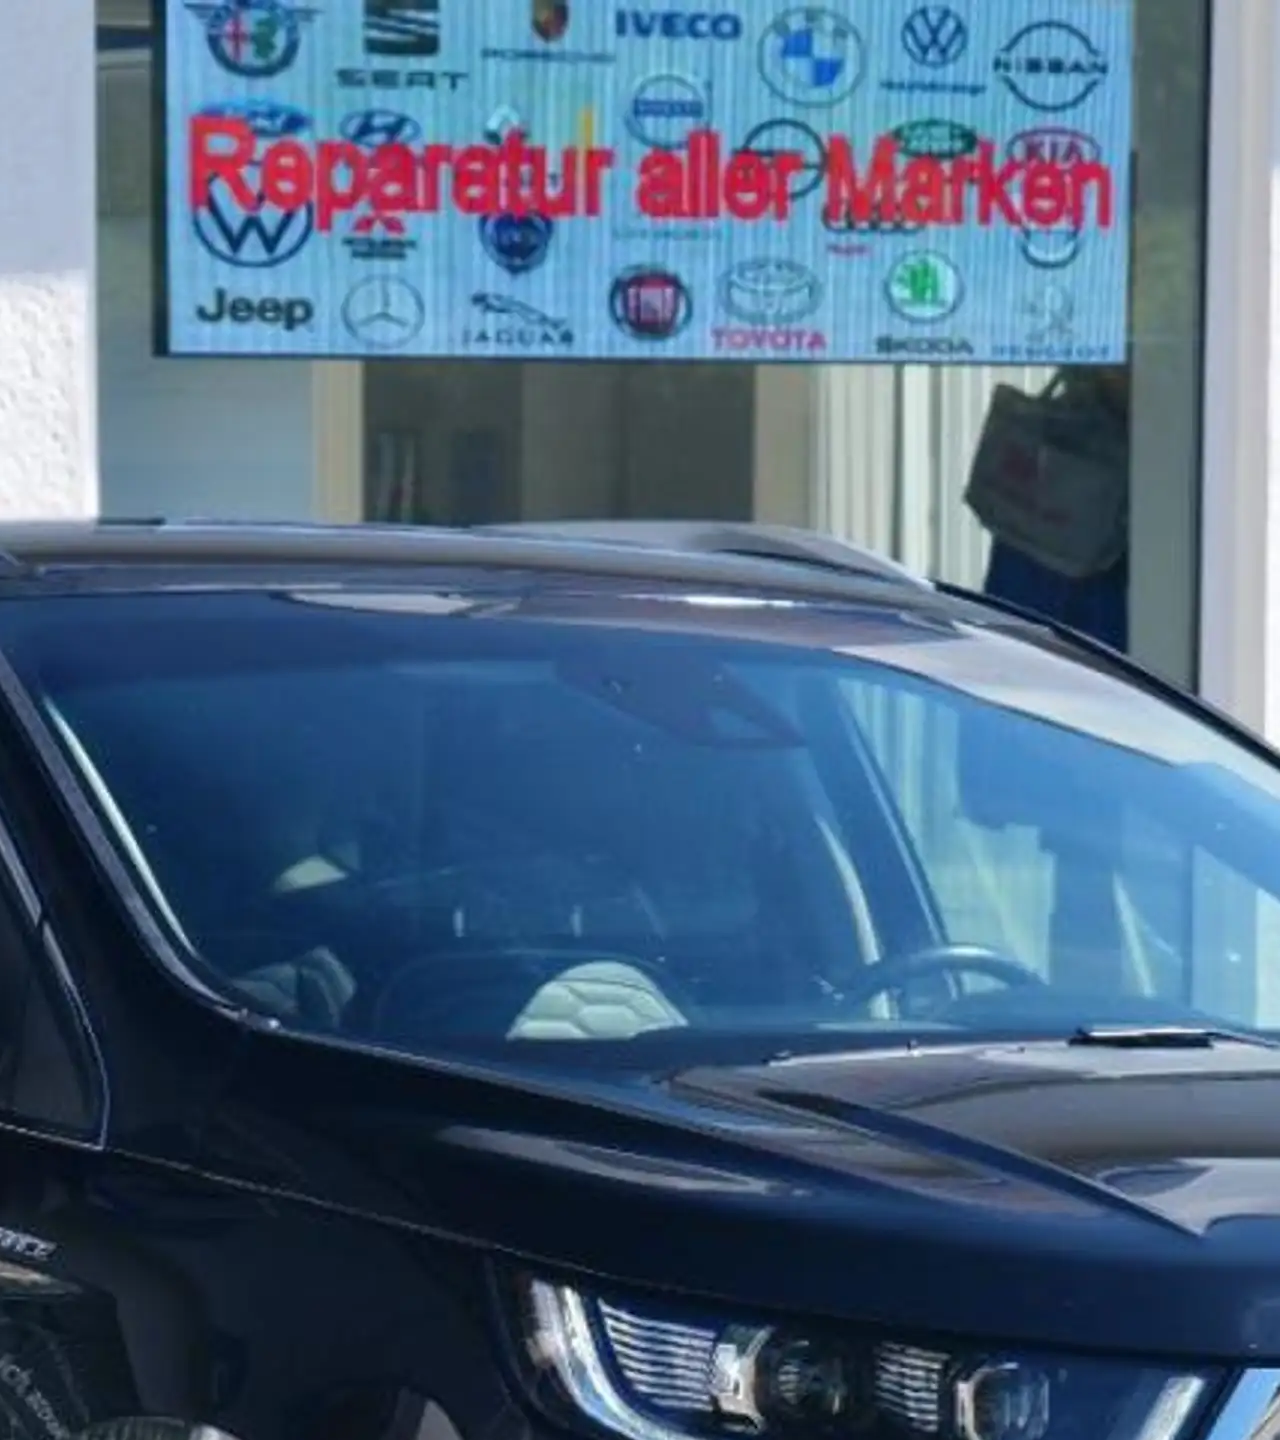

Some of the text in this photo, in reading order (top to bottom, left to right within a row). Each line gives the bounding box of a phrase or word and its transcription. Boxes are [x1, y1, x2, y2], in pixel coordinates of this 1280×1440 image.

[615, 10, 742, 39] IVECO
[992, 56, 1108, 75] NISSAN
[336, 68, 468, 91] SEAT
[188, 114, 1112, 234] Reparatur aller Marken
[196, 288, 314, 332] Jeep
[460, 326, 575, 346] JAGUAR
[712, 328, 826, 350] TOYOTA
